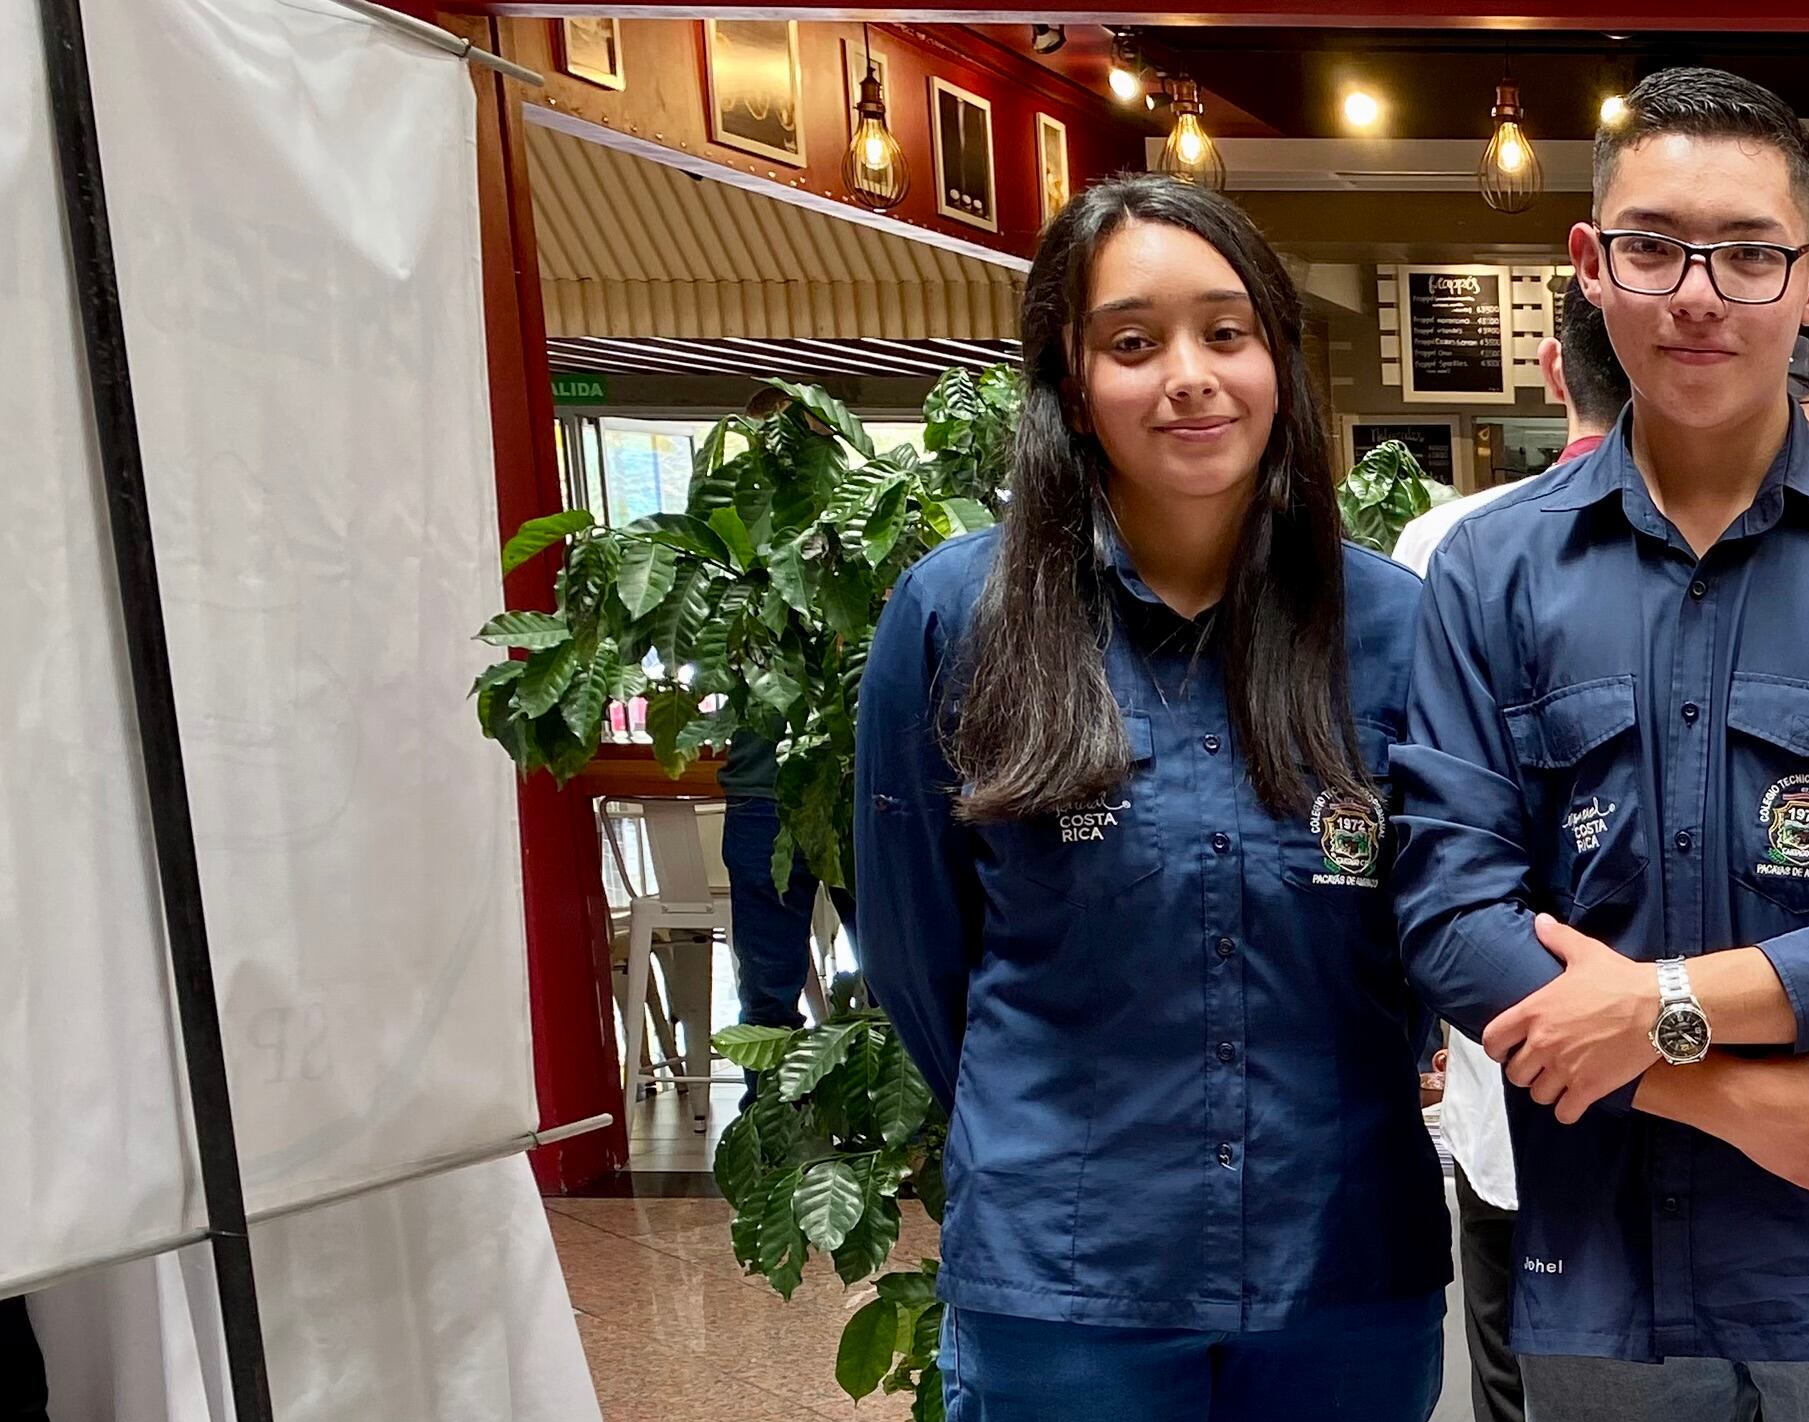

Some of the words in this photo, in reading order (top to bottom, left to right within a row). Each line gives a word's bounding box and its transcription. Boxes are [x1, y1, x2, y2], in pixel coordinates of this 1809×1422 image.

[551, 382, 604, 397] ALIDA
[1759, 784, 1780, 823] COLEGIO
[1060, 812, 1118, 828] COSTA
[1337, 817, 1366, 831] 1972
[1062, 826, 1104, 843] RICA
[1574, 818, 1608, 839] COSTA
[1576, 834, 1600, 853] RICA
[1792, 867, 1803, 877] DE
[1346, 876, 1356, 885] DE
